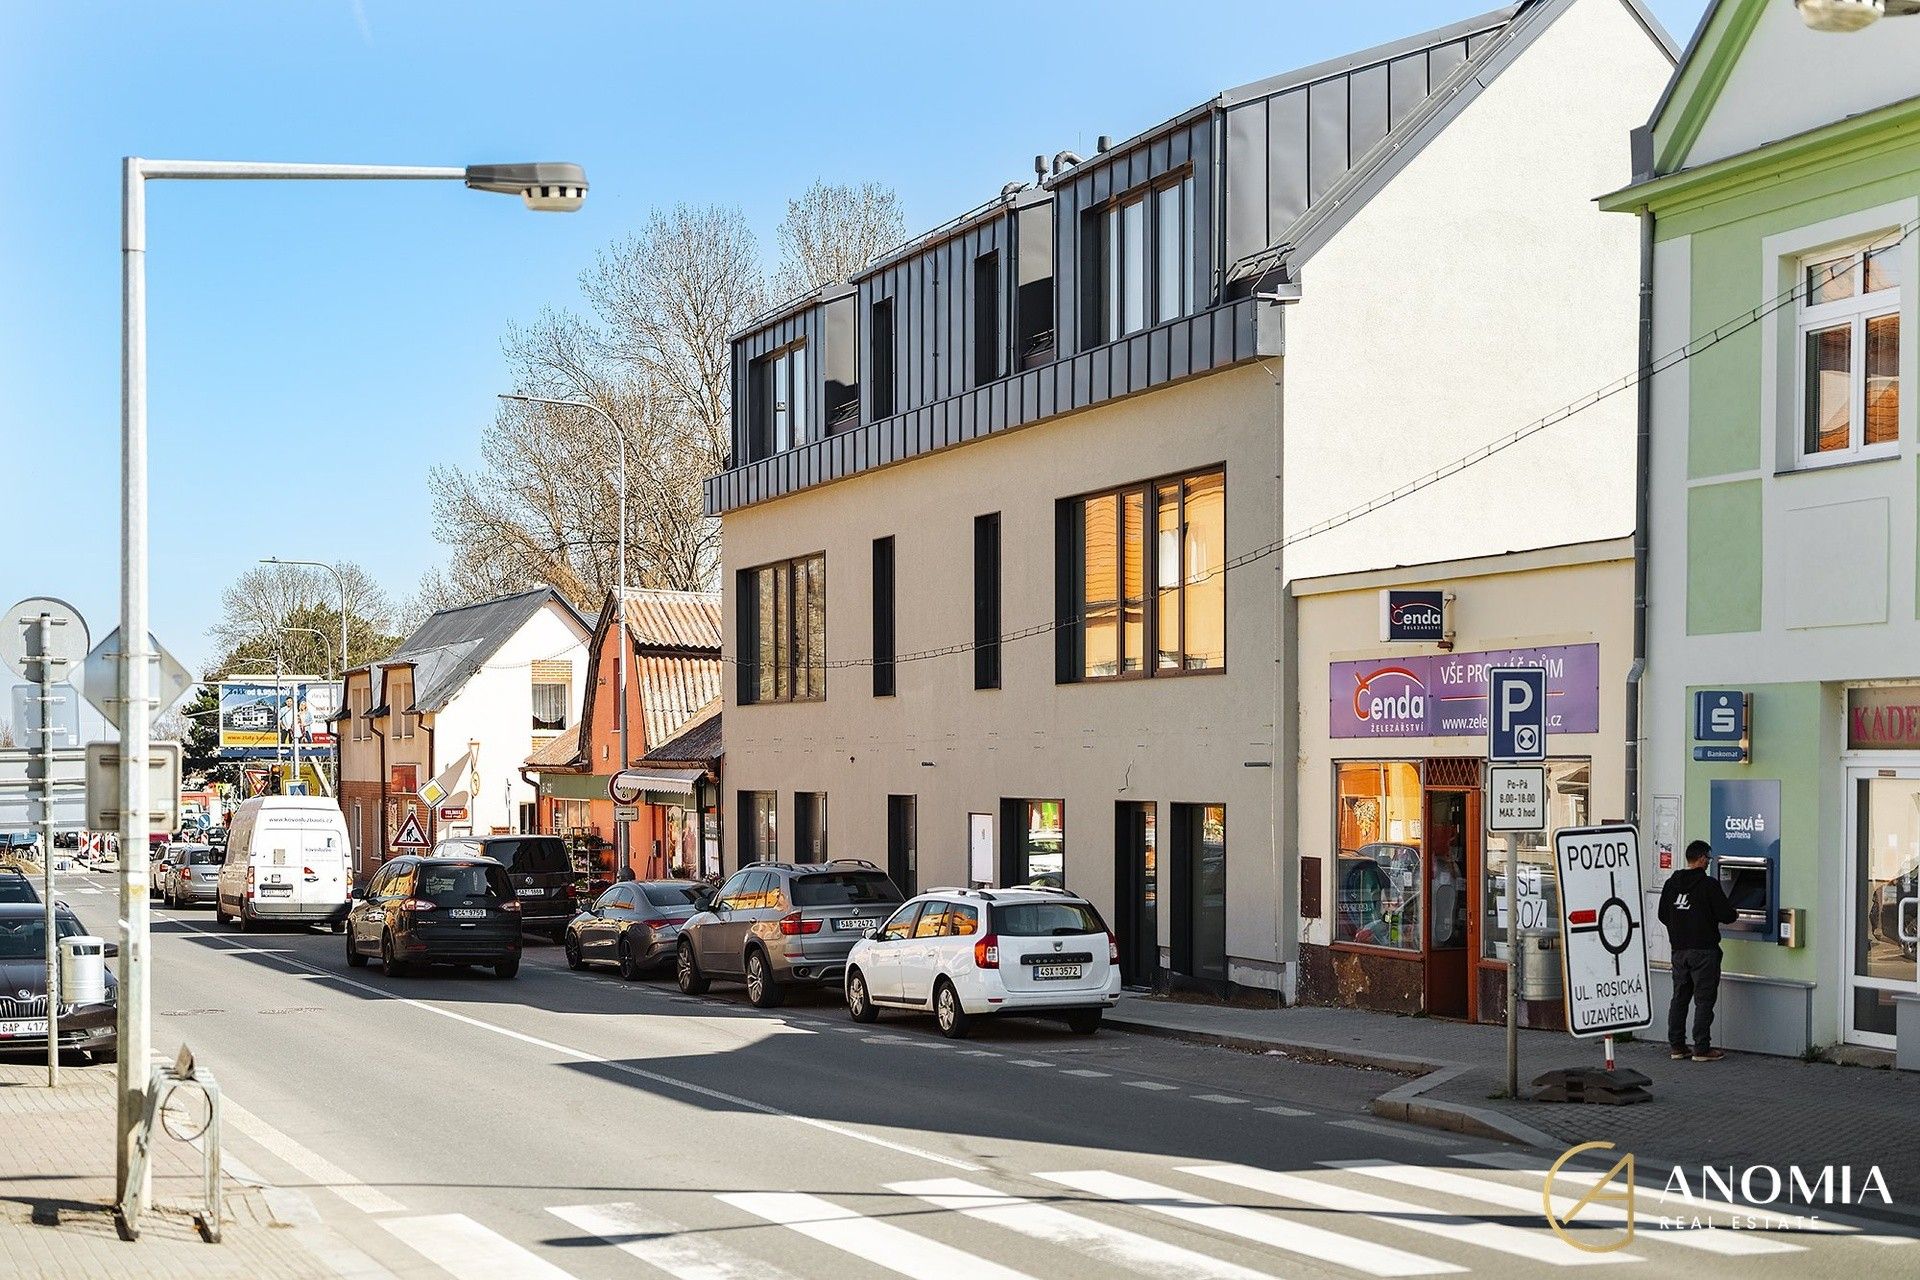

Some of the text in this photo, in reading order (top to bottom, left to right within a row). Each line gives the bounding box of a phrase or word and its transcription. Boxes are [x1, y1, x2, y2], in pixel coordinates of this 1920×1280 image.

[1390, 603, 1441, 625] Čenda
[1440, 660, 1464, 685] VŠE
[1353, 666, 1425, 721] Čenda
[1501, 679, 1534, 732] P
[1370, 720, 1424, 733] ŽELEZÁŘSTVÍ
[1707, 750, 1738, 758] Bankomat
[1517, 807, 1522, 817] 3
[1523, 807, 1536, 817] hod
[1725, 815, 1754, 831] ČESKÁ
[1725, 831, 1751, 840] spořitelna
[1567, 842, 1630, 871] POZOR
[856, 918, 874, 927] 2472
[1040, 966, 1078, 976] 4SX 3572
[1575, 974, 1643, 1001] UL. ROSICKÁ
